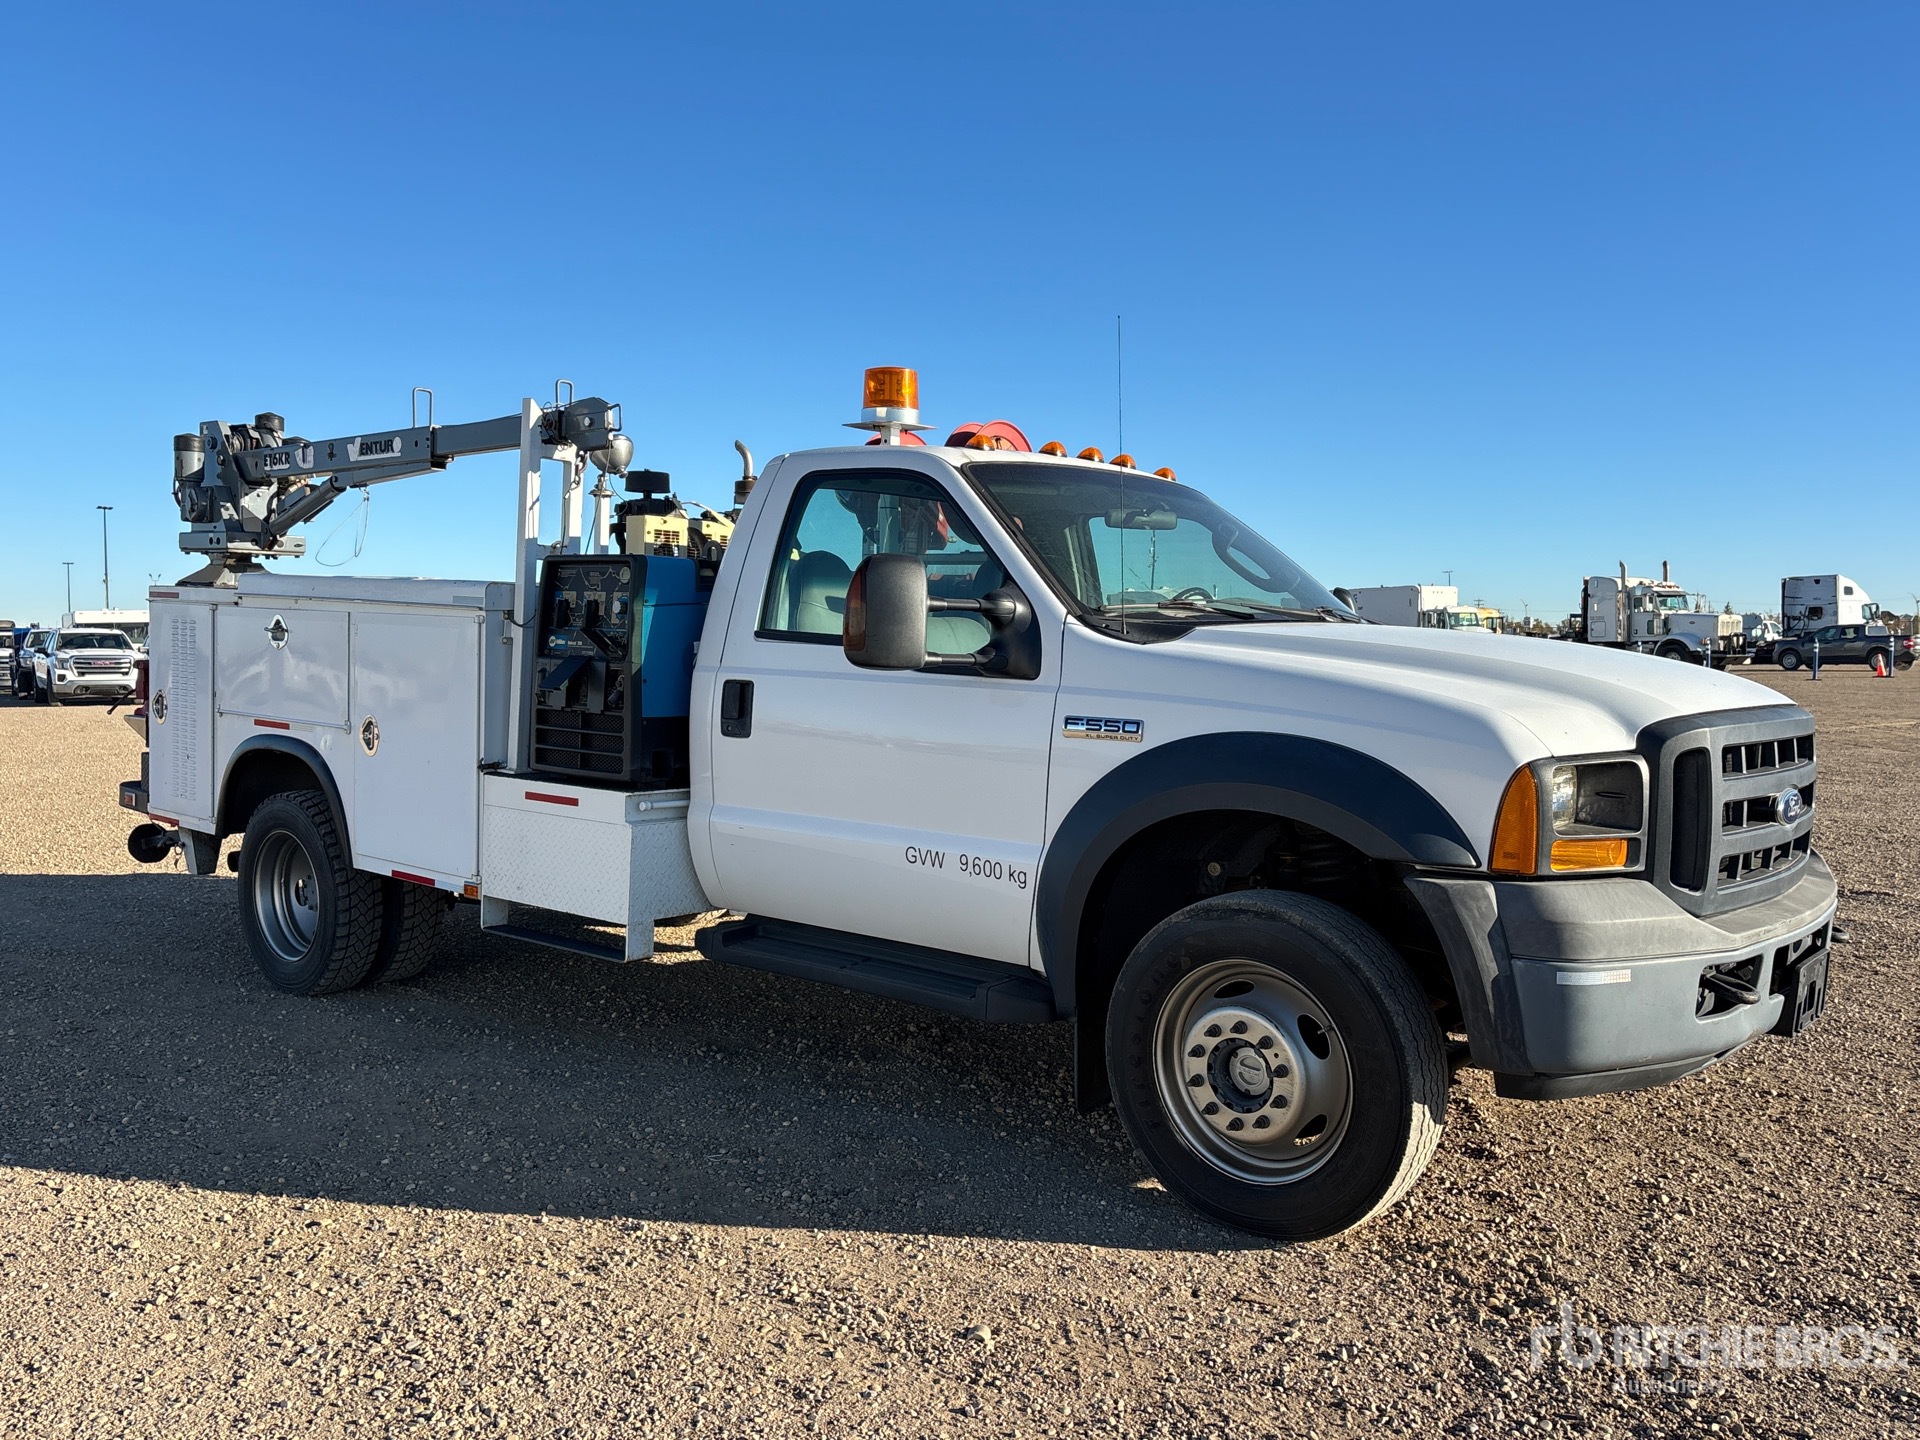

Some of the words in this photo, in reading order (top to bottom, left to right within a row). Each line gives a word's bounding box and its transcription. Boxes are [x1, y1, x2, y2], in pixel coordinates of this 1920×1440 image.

[905, 846, 945, 869] GVW
[959, 853, 1003, 880] 9,600
[1008, 864, 1027, 889] kg
